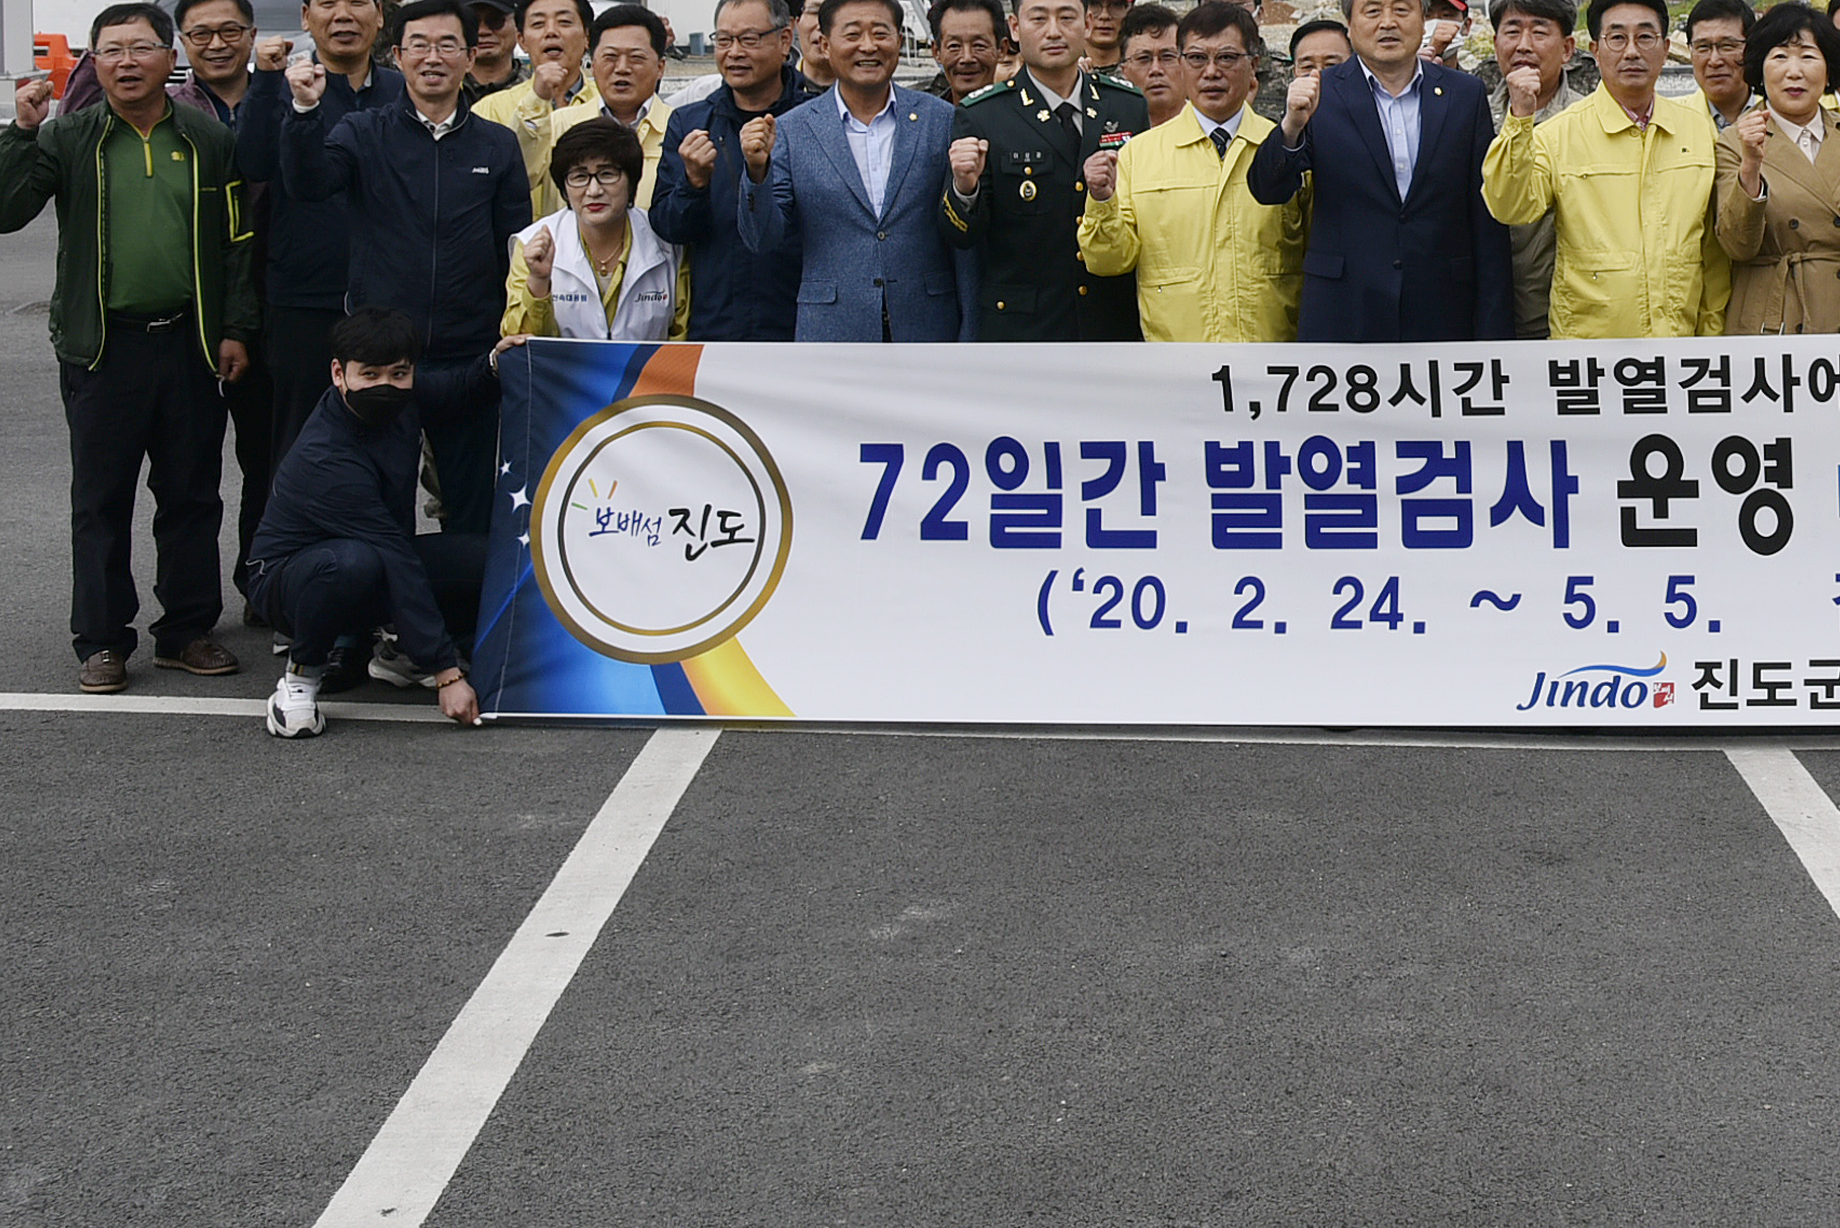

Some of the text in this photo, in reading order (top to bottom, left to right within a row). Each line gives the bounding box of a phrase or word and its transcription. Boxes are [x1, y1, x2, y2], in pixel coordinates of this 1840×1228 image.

[634, 291, 663, 303] Jindo
[1212, 358, 1510, 420] 1,728시간
[860, 435, 1167, 550] 72일간
[1204, 435, 1579, 550] 발열검사
[1616, 433, 1794, 556] 운영
[588, 503, 756, 562] 보배섬 진도
[1231, 576, 1287, 634] 2.
[1330, 575, 1426, 634] 24.
[1562, 575, 1620, 633] 5.
[1664, 575, 1721, 633] 5.
[1516, 671, 1649, 711] Jindo
